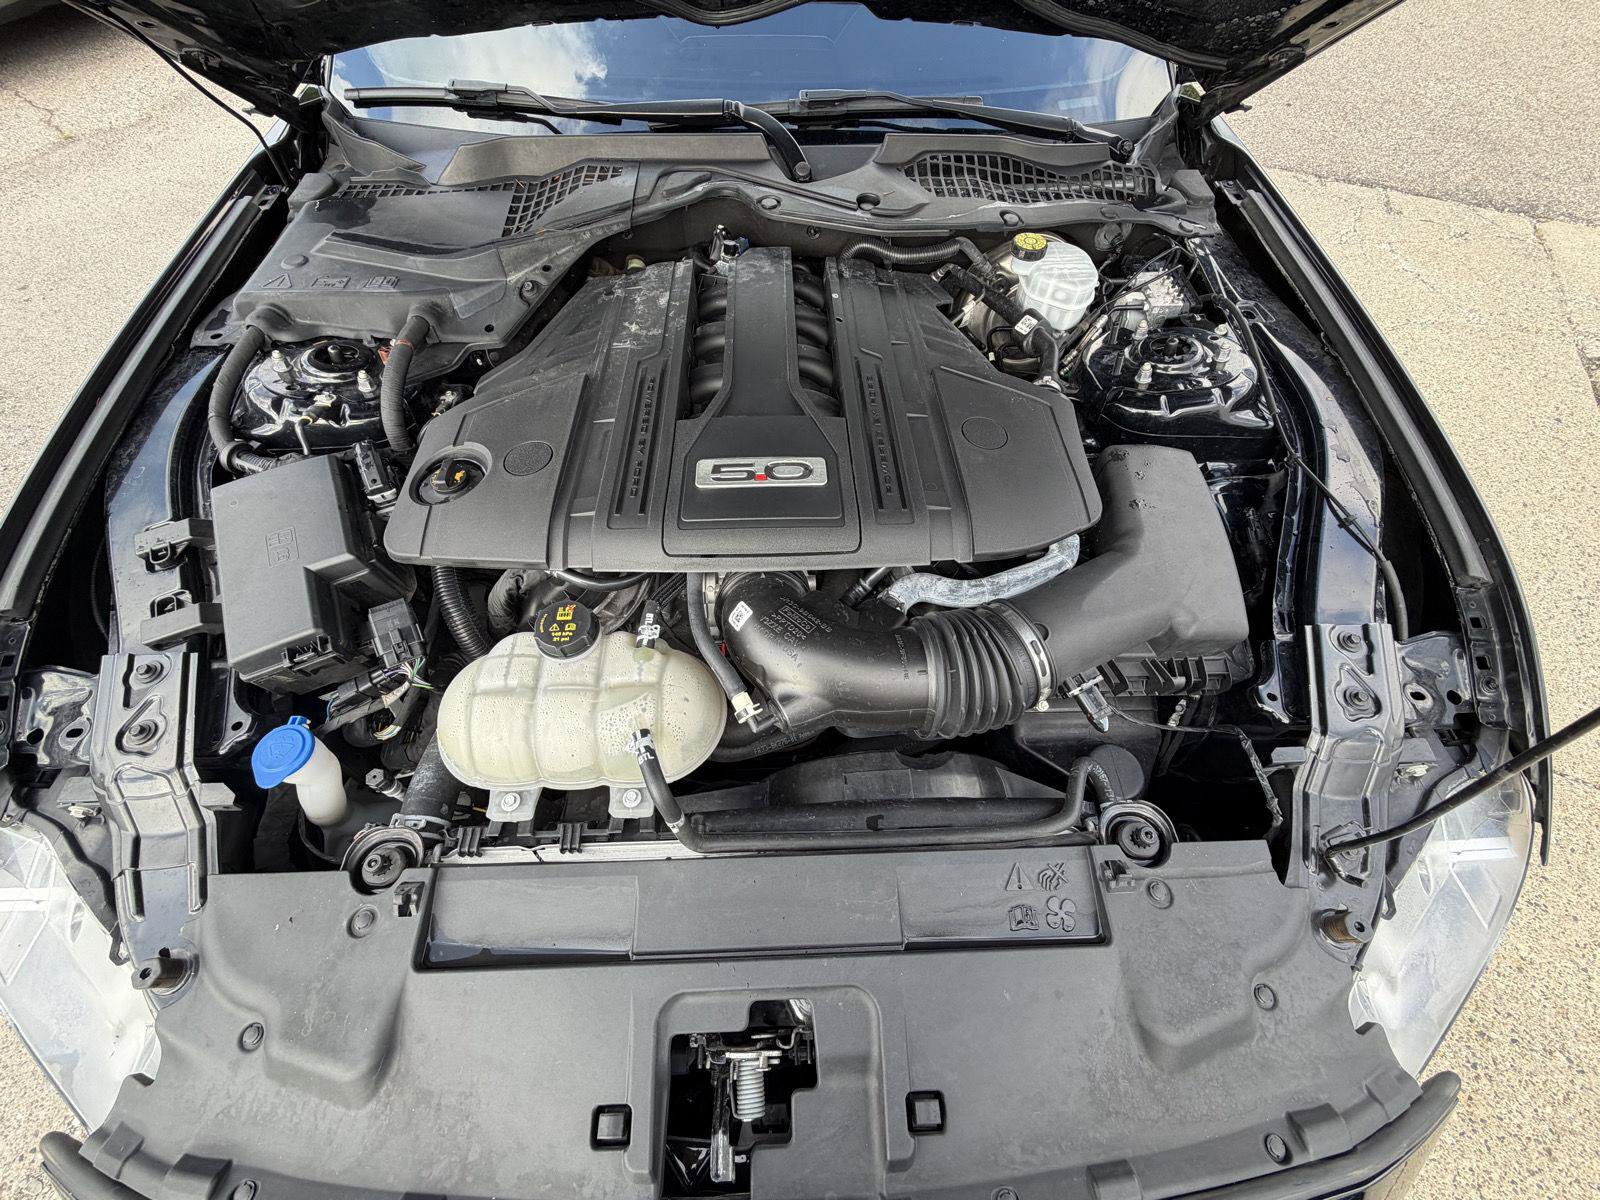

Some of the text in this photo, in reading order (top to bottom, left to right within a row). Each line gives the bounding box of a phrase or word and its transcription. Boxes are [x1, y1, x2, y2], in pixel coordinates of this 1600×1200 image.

[629, 376, 656, 498] POWERED BY FORD
[711, 461, 814, 481] 5.0
[874, 430, 894, 496] POWERED
[782, 606, 812, 630] FoMoCo
[638, 752, 655, 765] BTL
